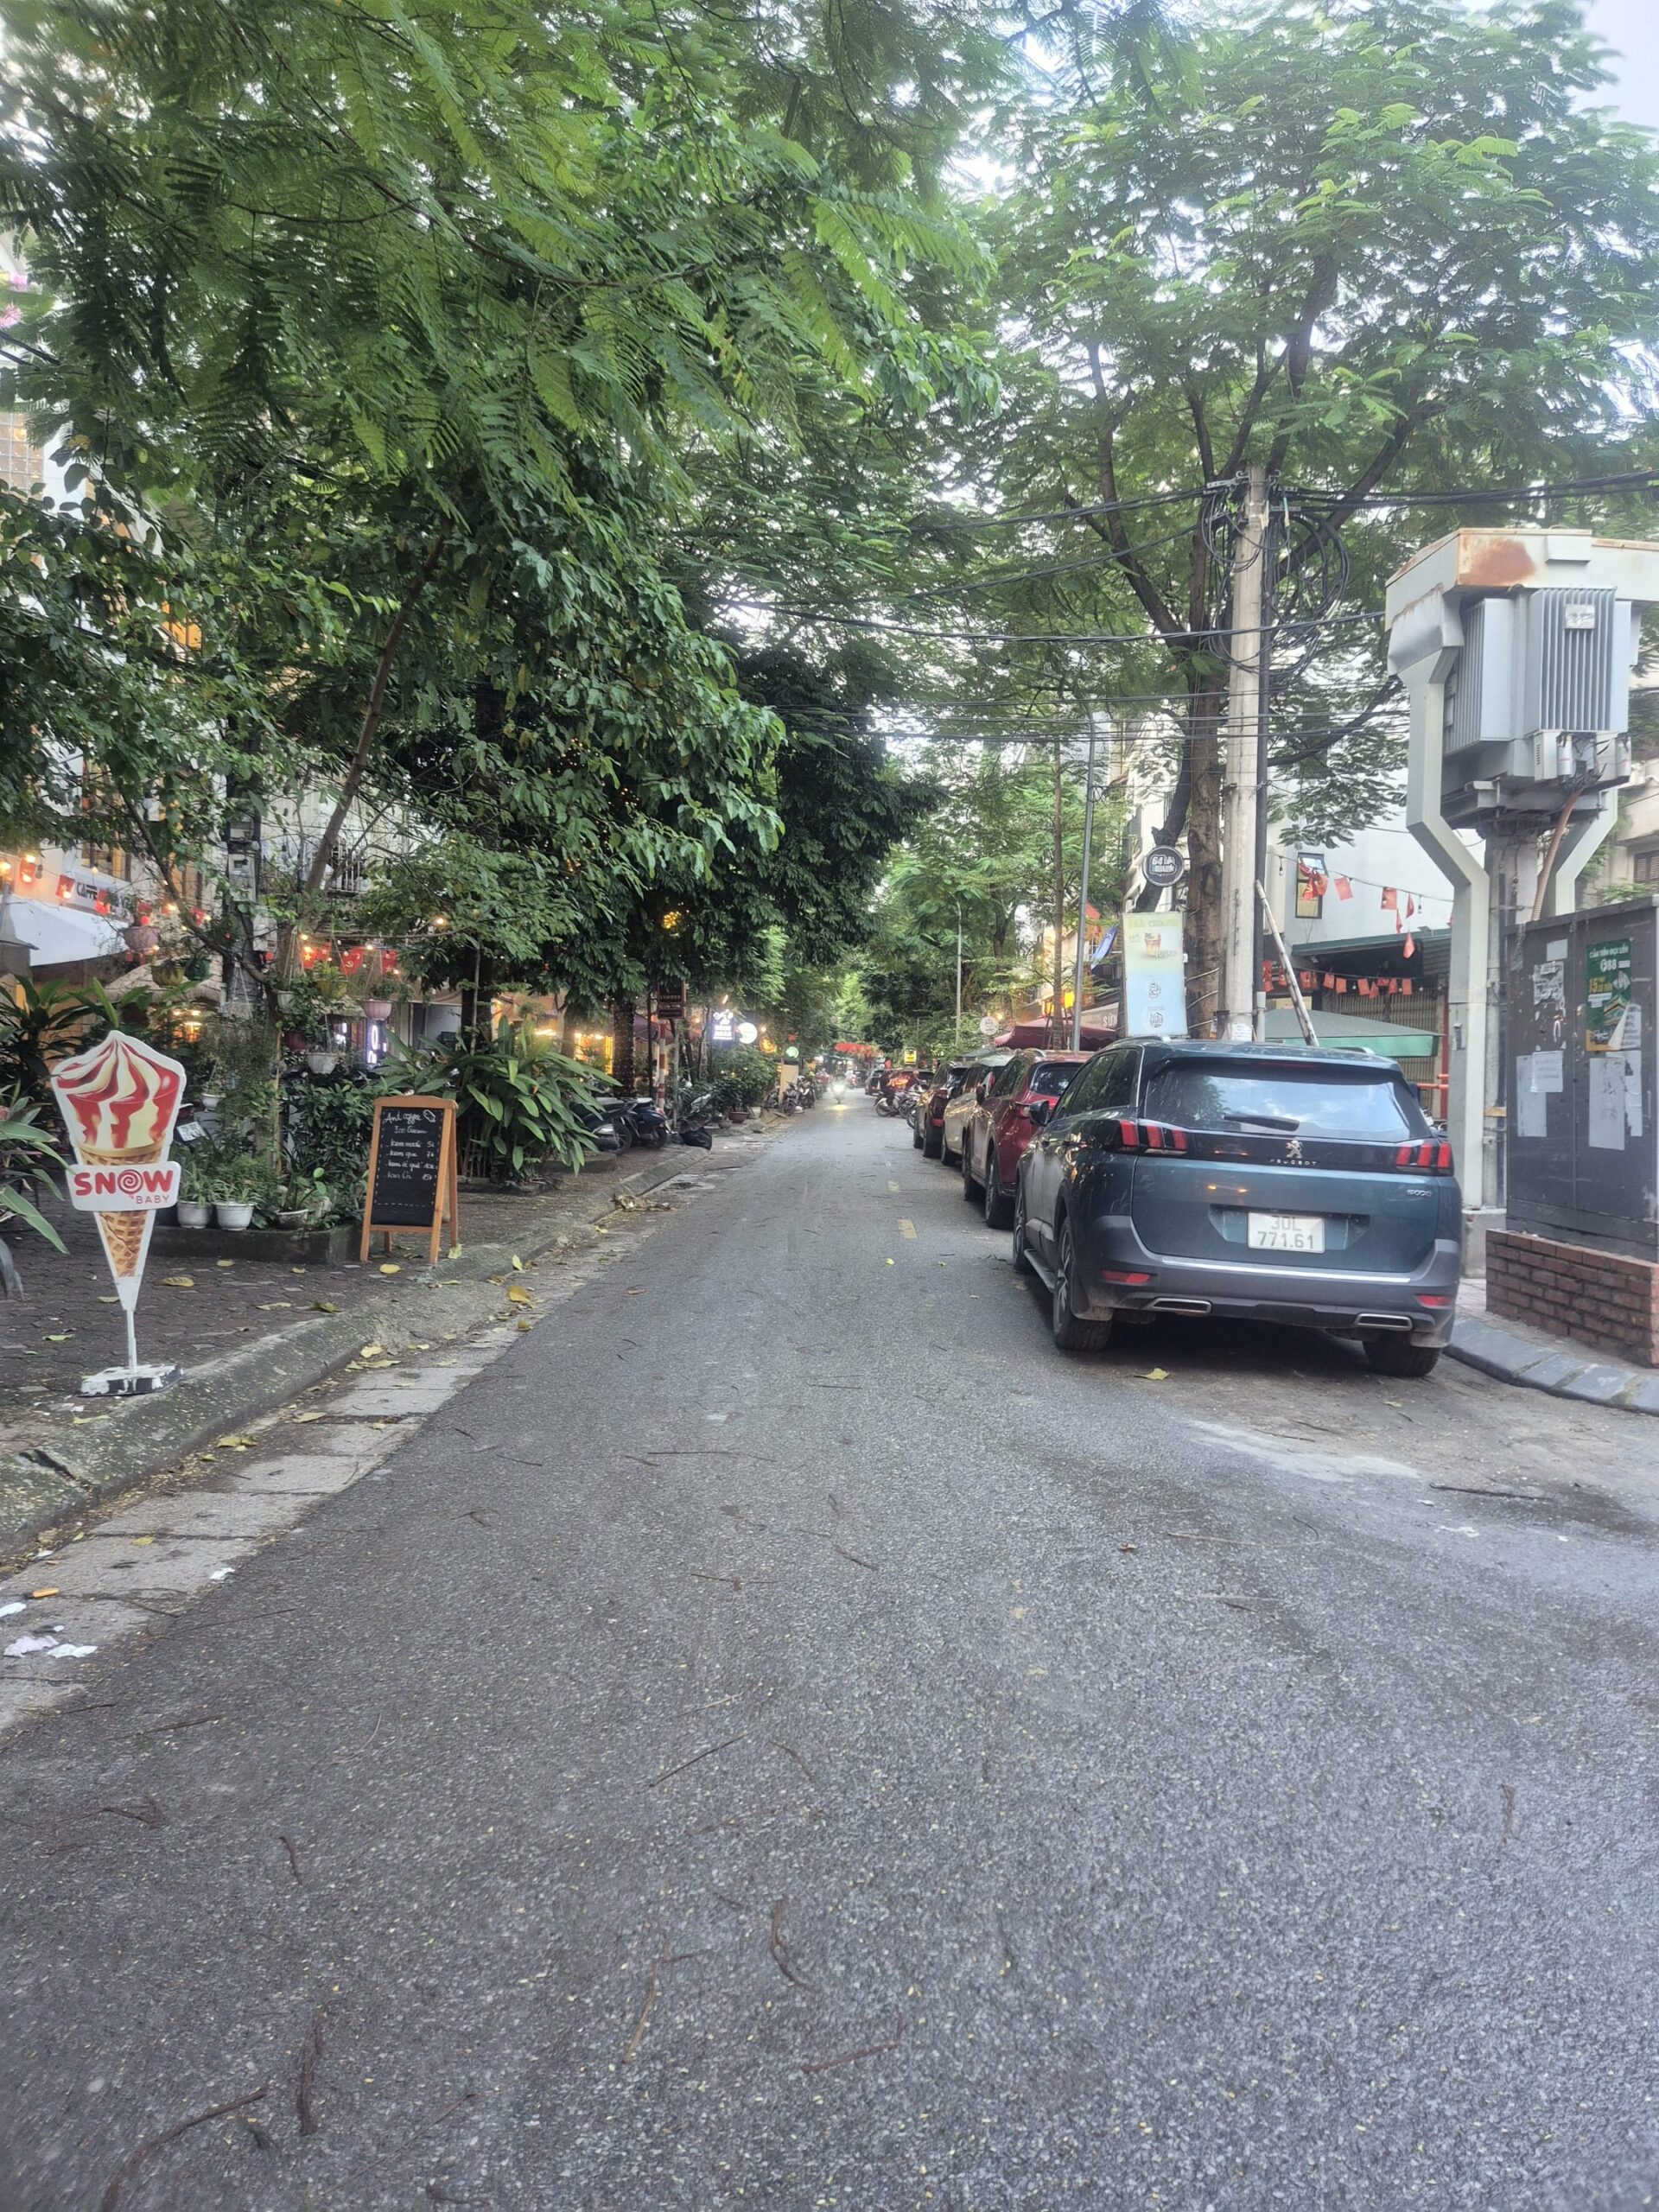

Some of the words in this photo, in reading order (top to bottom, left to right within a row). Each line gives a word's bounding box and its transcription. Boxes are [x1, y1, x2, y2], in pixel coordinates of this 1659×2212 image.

[73, 1169, 174, 1196] SNOW
[136, 1195, 170, 1205] BABY
[1270, 1215, 1302, 1231] 30L
[1257, 1230, 1314, 1249] 771.61
